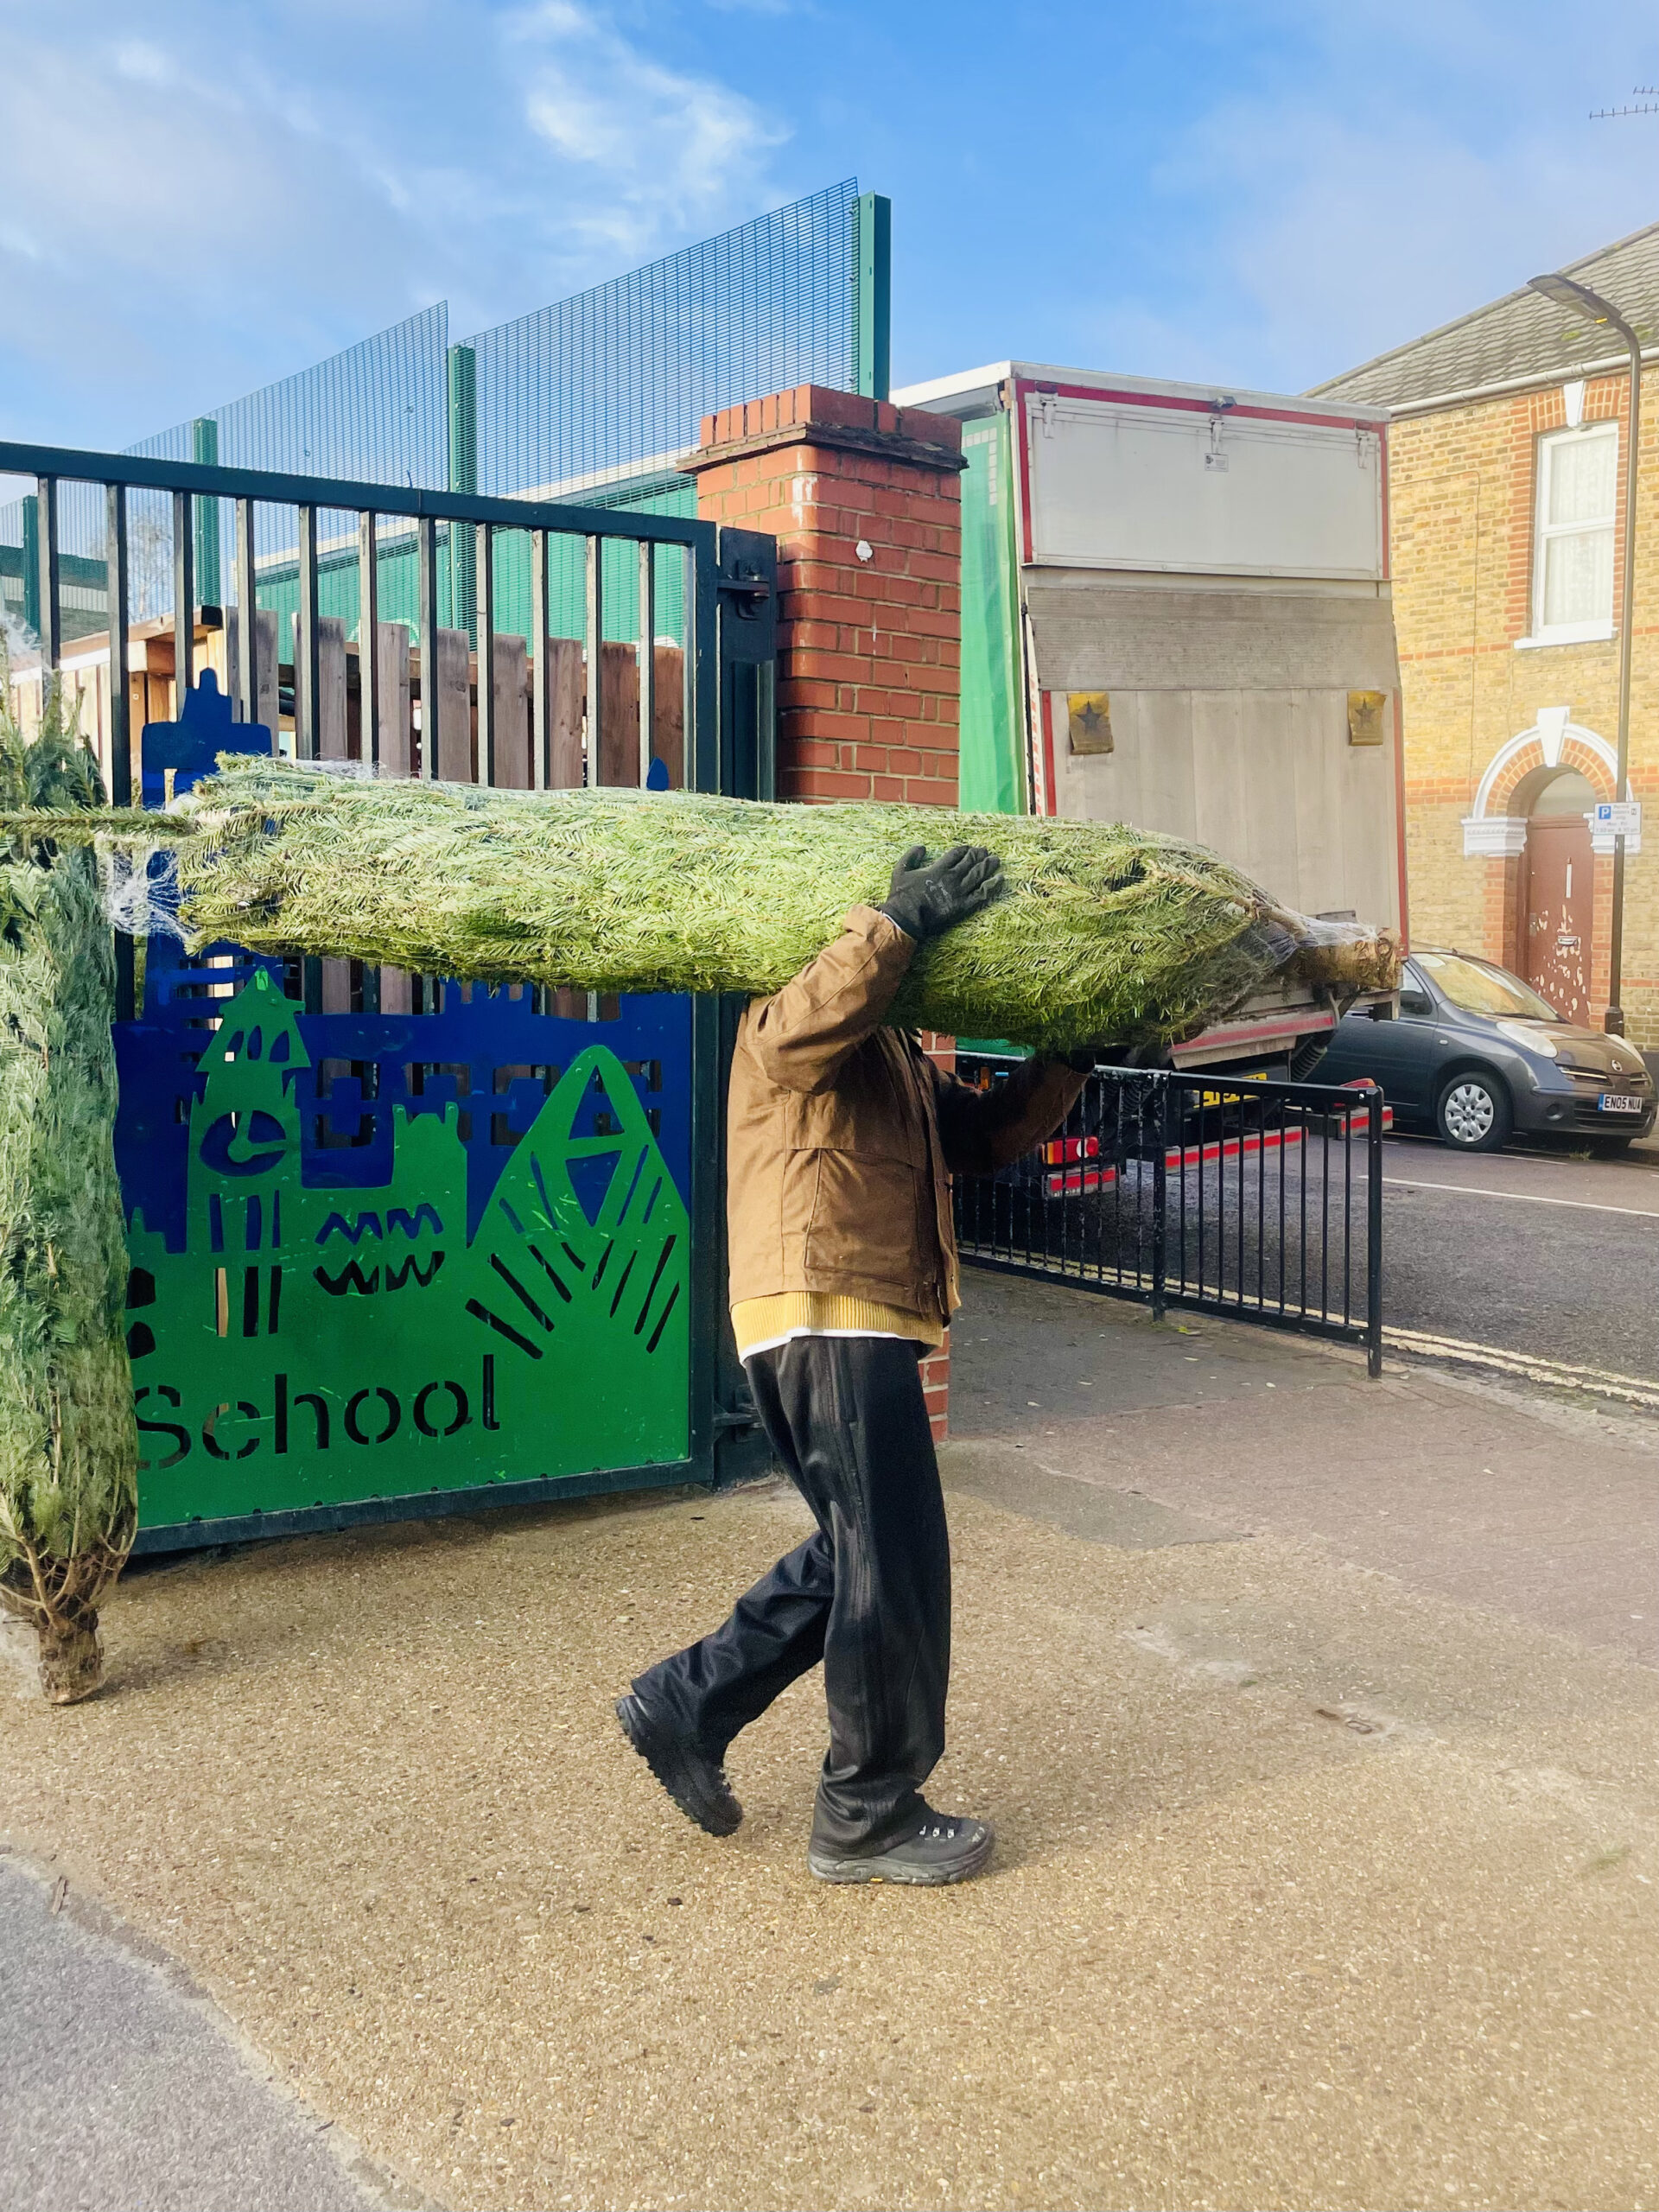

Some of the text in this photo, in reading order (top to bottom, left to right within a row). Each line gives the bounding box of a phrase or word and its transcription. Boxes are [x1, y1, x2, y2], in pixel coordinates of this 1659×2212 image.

[1601, 807, 1610, 818] P
[1605, 1096, 1627, 1109] EN05
[134, 1353, 500, 1470] School
